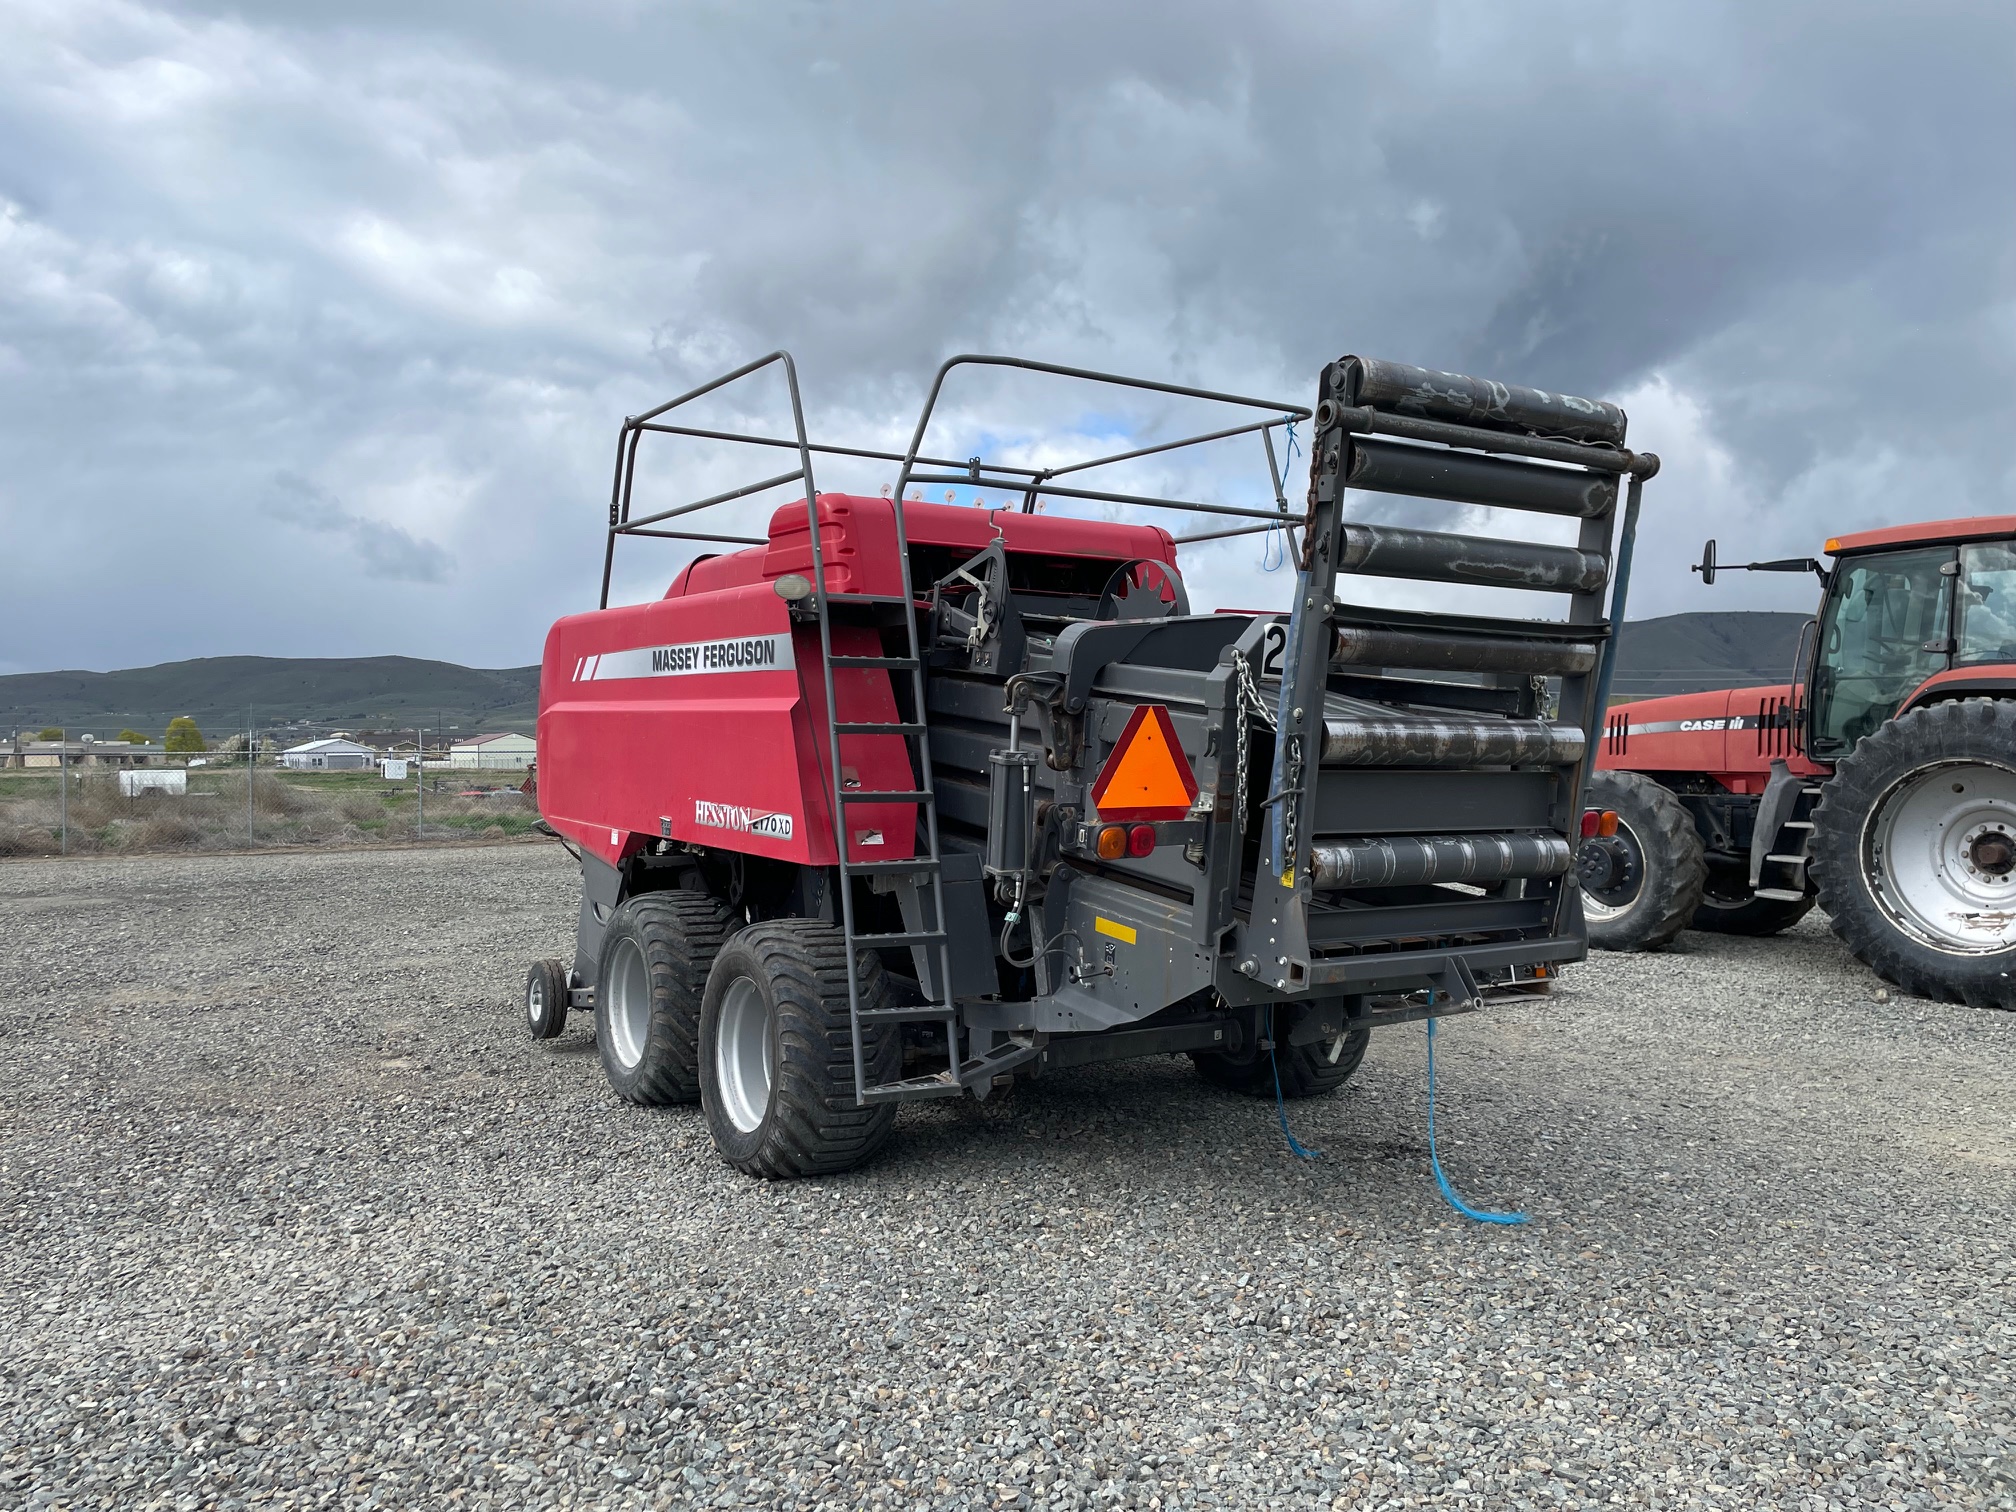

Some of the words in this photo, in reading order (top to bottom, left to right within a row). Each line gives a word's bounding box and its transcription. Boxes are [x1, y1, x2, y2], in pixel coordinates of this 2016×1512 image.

[652, 646, 700, 672] MASSEY
[703, 639, 776, 669] FERGUSON
[1264, 625, 1287, 675] 2
[1680, 719, 1726, 732] CASE
[695, 800, 750, 832] HESSTON
